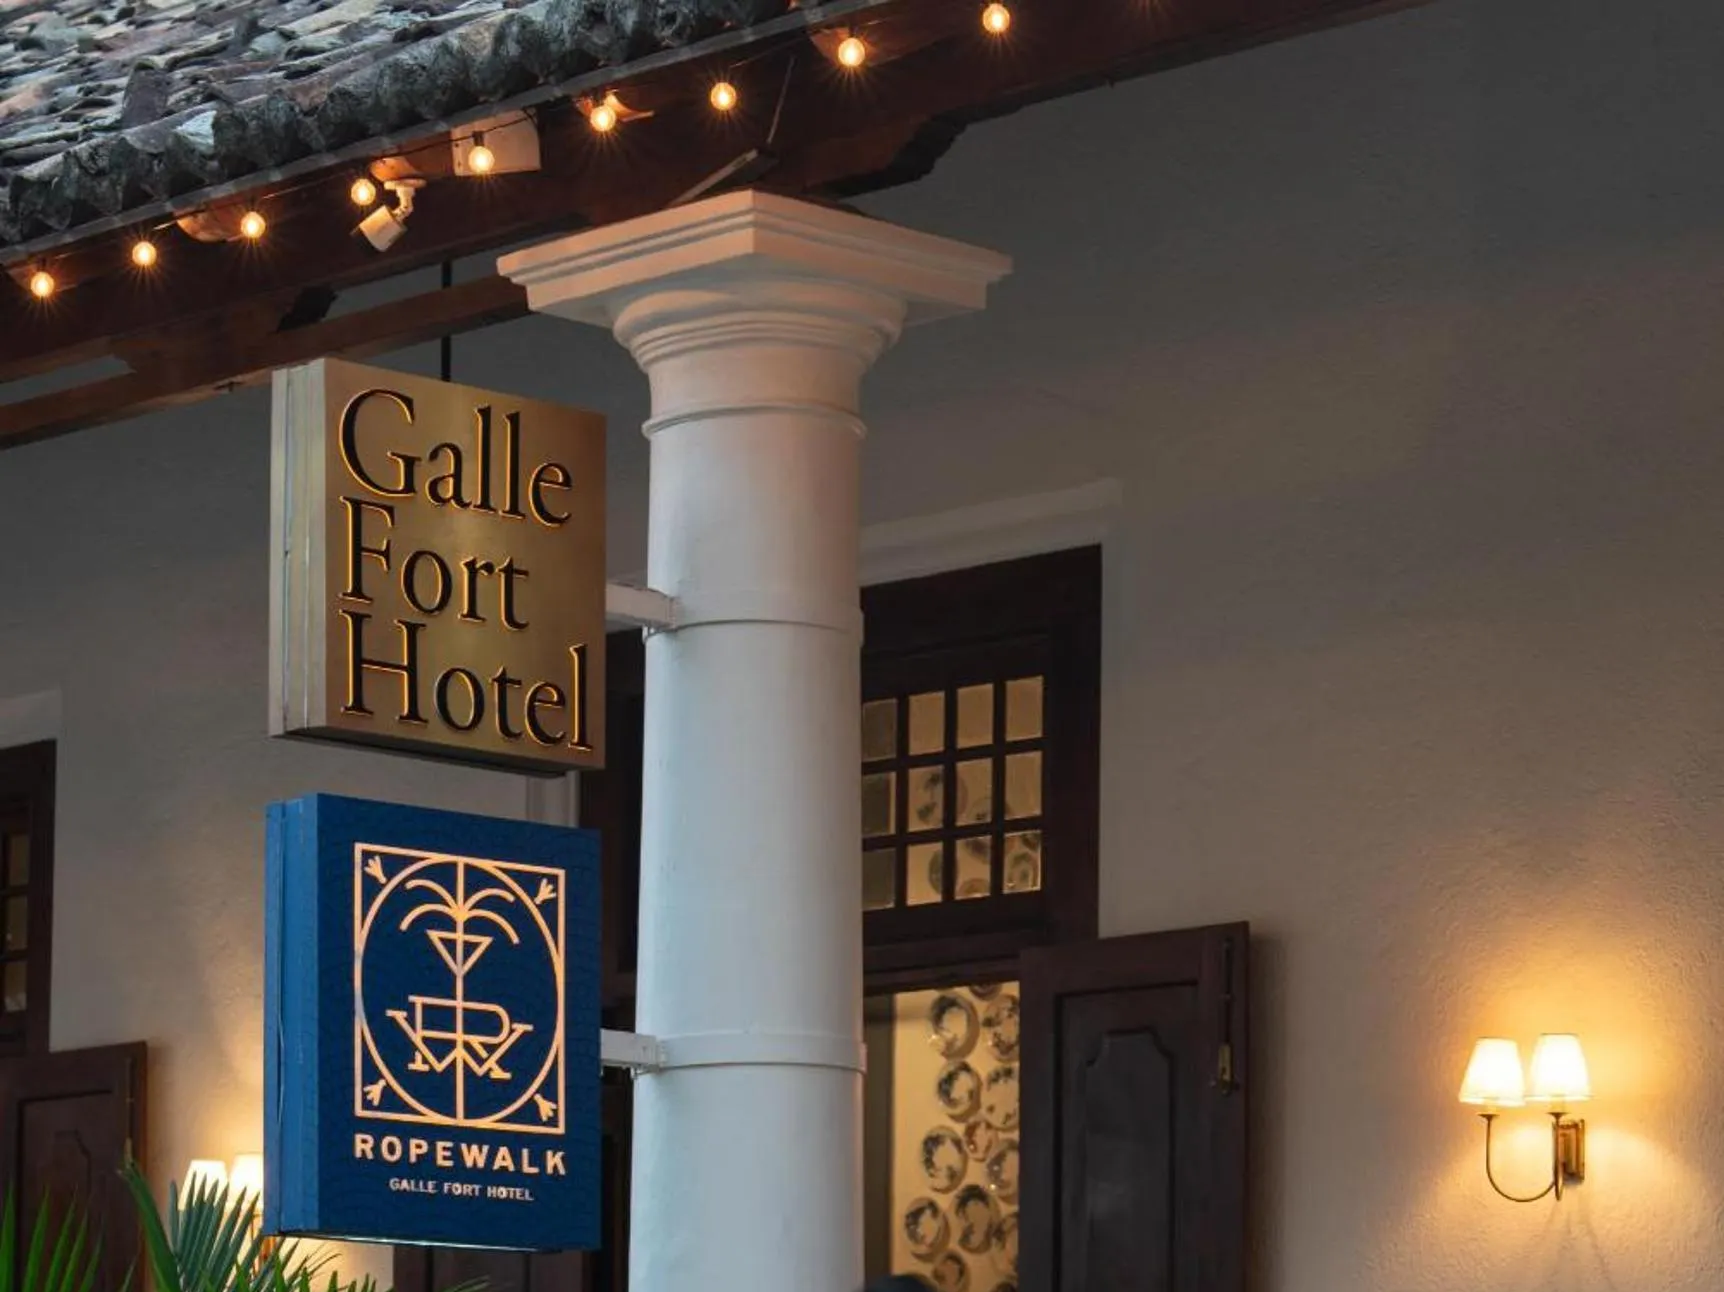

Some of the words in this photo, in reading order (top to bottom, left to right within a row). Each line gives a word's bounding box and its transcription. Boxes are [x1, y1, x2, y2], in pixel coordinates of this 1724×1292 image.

[338, 388, 573, 527] Galle
[337, 496, 530, 631] Fort
[338, 608, 593, 752] Hotel
[353, 1132, 567, 1176] ROPEWALK
[388, 1177, 437, 1194] GALLE
[443, 1182, 482, 1198] FORT
[486, 1185, 535, 1201] HOTEL
